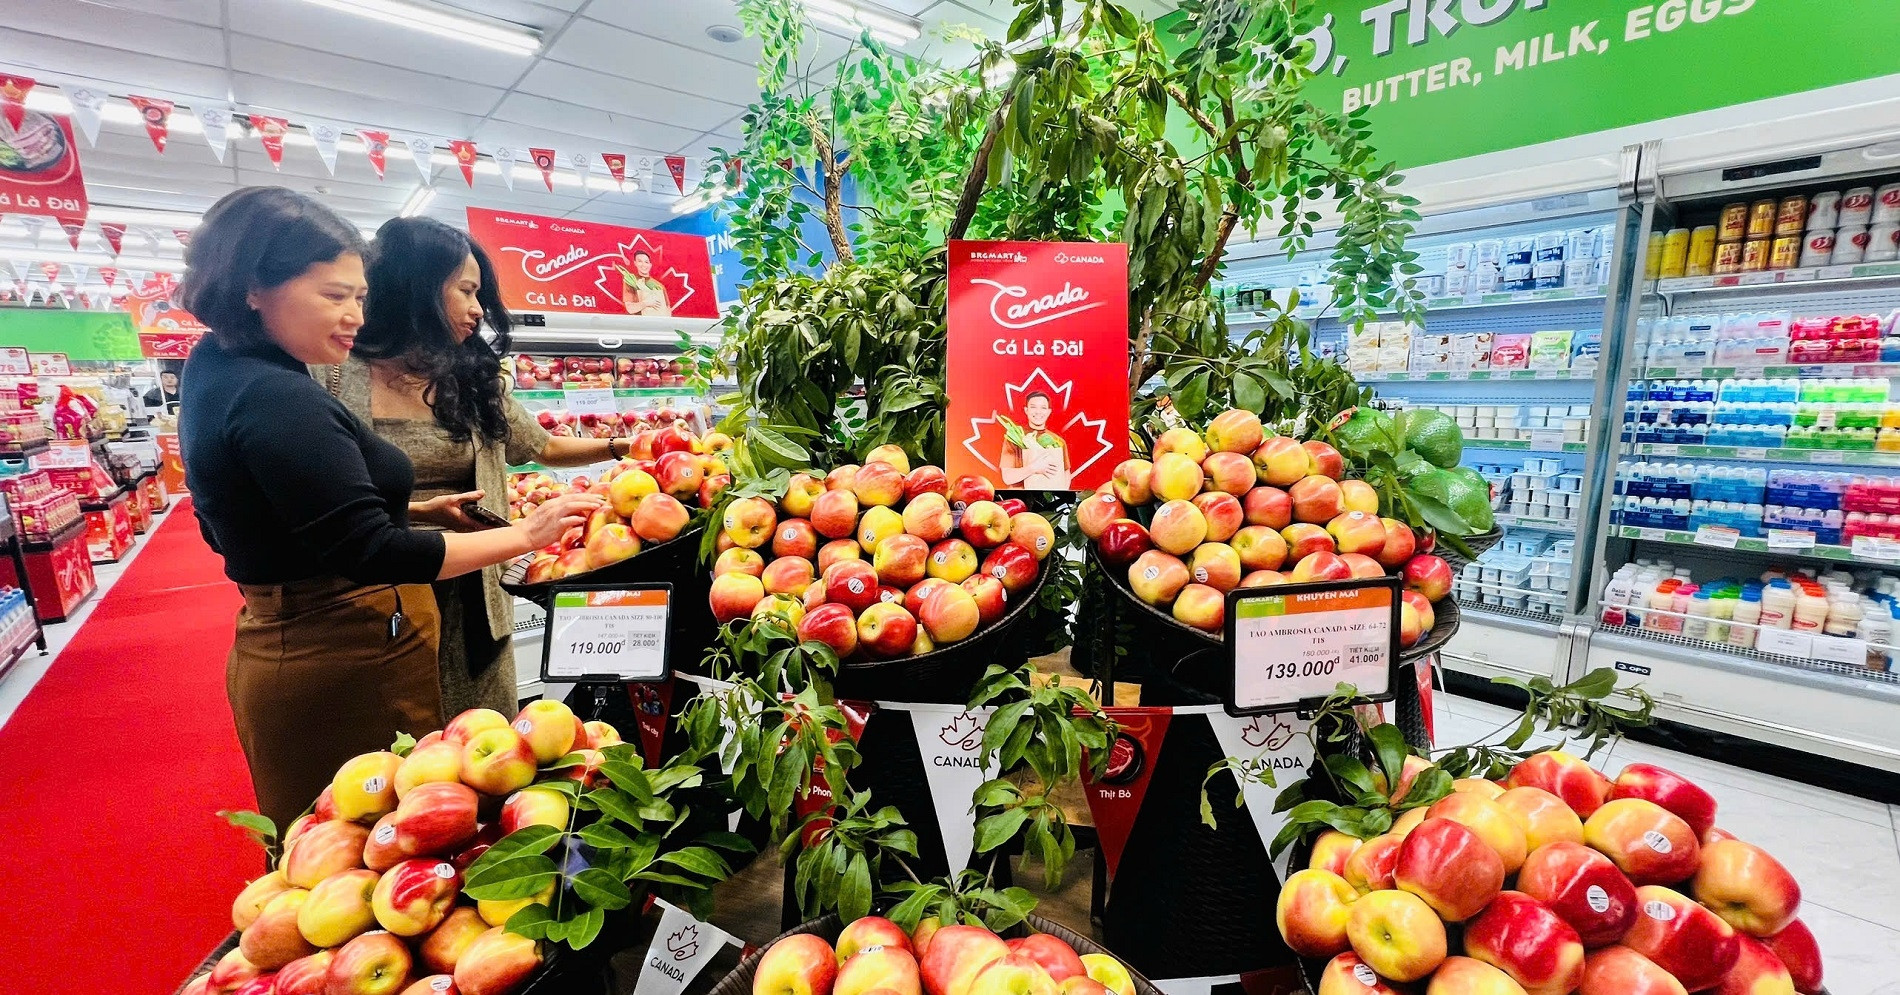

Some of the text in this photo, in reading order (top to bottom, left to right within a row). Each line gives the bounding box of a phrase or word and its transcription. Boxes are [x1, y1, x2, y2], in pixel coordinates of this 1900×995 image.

[1342, 57, 1482, 114] BUTTER,
[1495, 20, 1610, 76] MILK,
[16, 193, 40, 208] Là
[46, 196, 81, 212] Đã!
[560, 226, 585, 234] CANADA
[501, 244, 594, 282] Canada
[1069, 256, 1105, 264] CANADA
[525, 291, 597, 308] Cá Là Đã!
[970, 279, 1099, 329] Canada
[992, 338, 1084, 356] Cá Là Đã!
[1643, 476, 1678, 484] Vinamilk
[1639, 506, 1674, 515] Vinamilk
[1314, 624, 1348, 634] CANADA
[1349, 623, 1366, 631] SIZE
[933, 755, 992, 769] CANAD
[1099, 789, 1132, 800] Thịt Bò
[650, 956, 686, 985] CANADA
